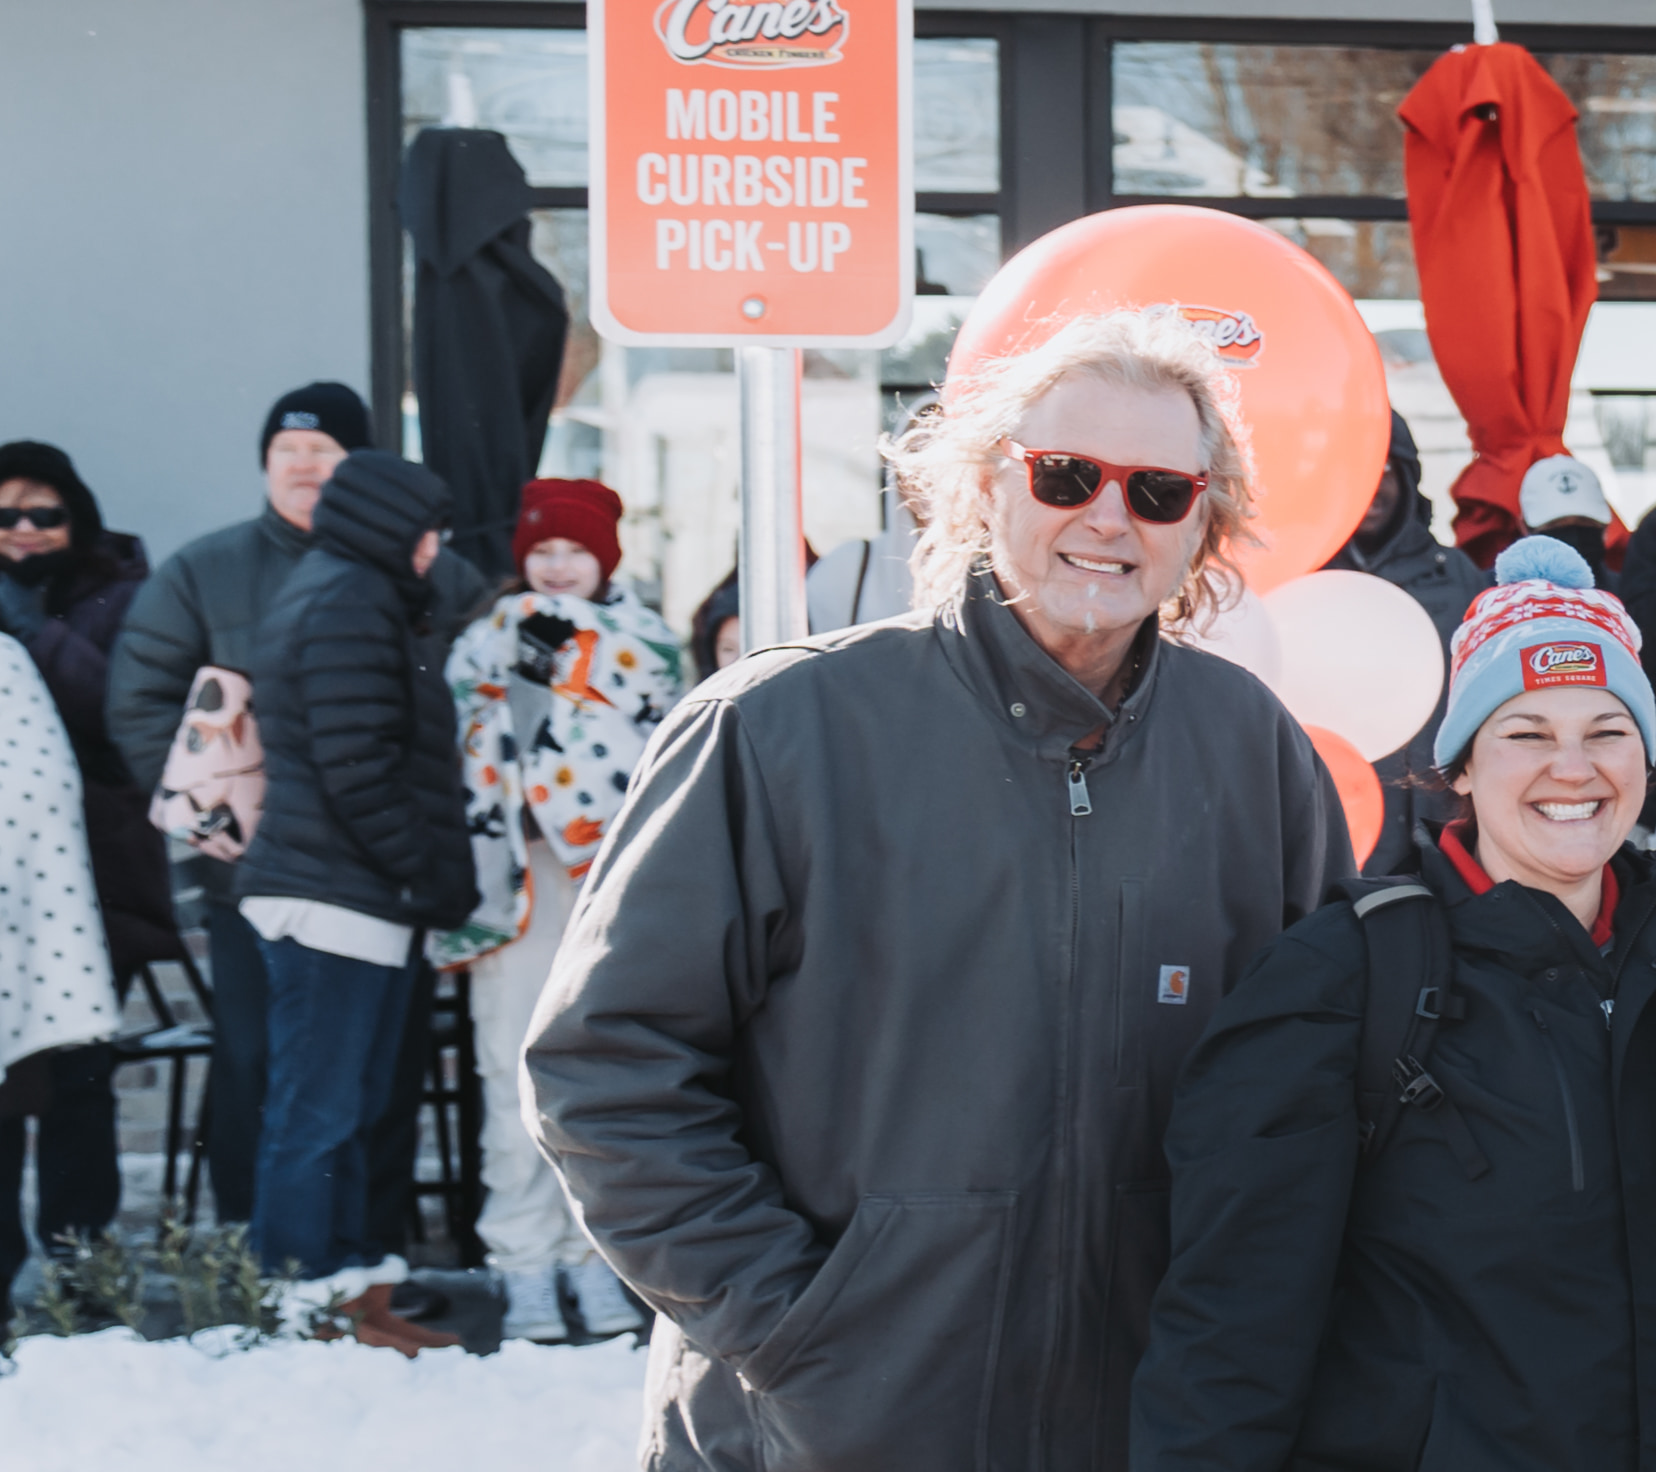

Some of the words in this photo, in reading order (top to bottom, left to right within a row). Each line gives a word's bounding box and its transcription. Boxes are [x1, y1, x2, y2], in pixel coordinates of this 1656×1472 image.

[665, 88, 840, 143] MOBILE
[636, 153, 869, 208] CURBSIDE
[655, 218, 852, 273] PICK-UP
[1533, 645, 1594, 673] Cane's
